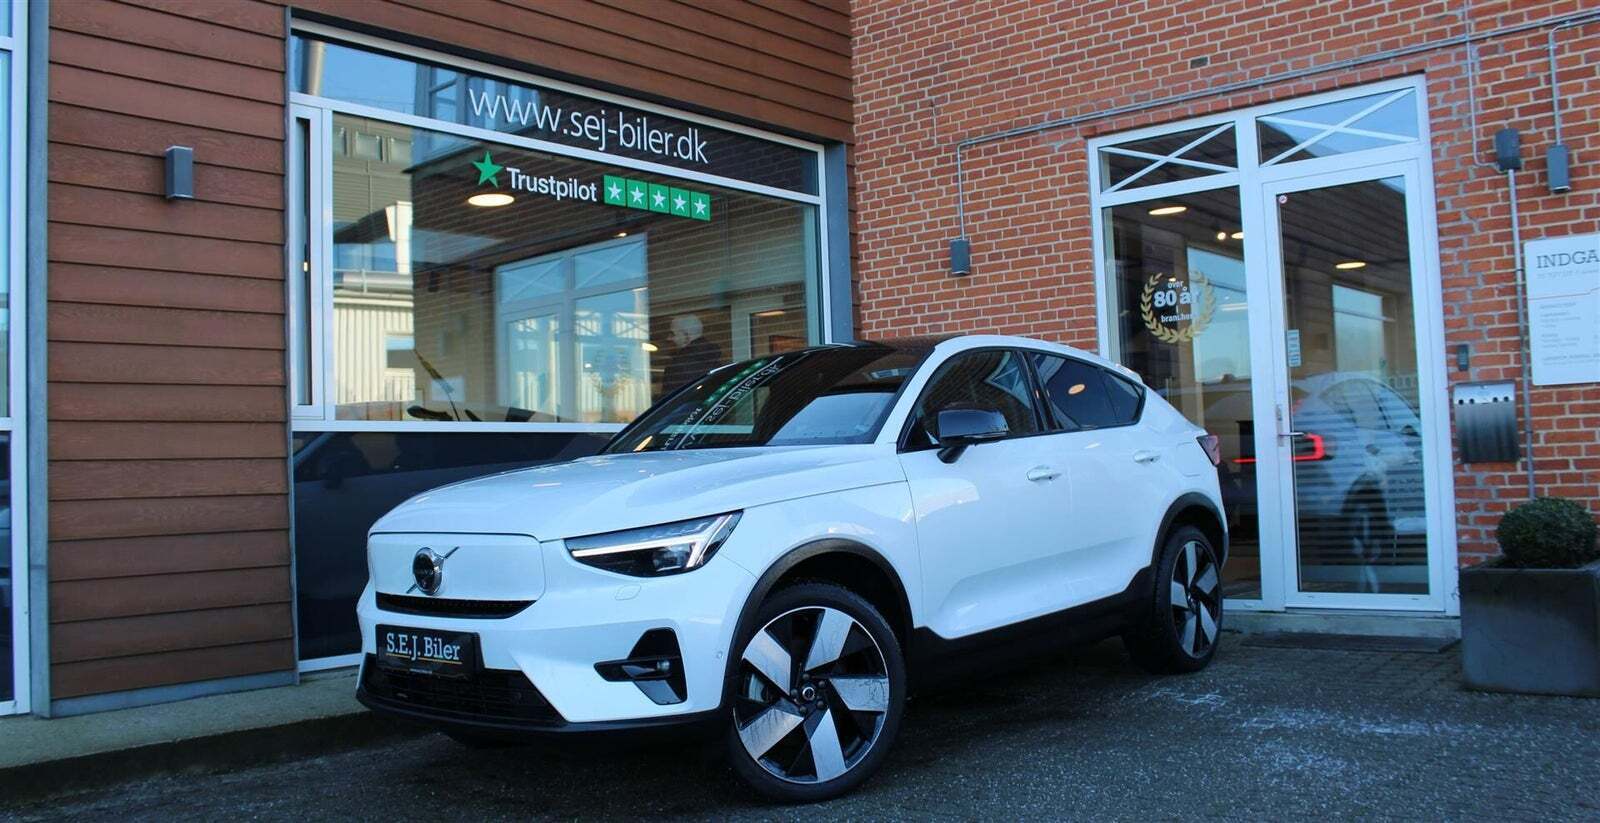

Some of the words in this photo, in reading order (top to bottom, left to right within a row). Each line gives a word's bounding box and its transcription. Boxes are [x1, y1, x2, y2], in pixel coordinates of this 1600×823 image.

[469, 88, 709, 164] www.sej-biler.dk
[506, 166, 598, 202] Trustpilot
[1154, 290, 1177, 308] 80
[1168, 281, 1184, 289] over
[386, 632, 421, 661] S.E.J.
[423, 636, 461, 661] Biler
